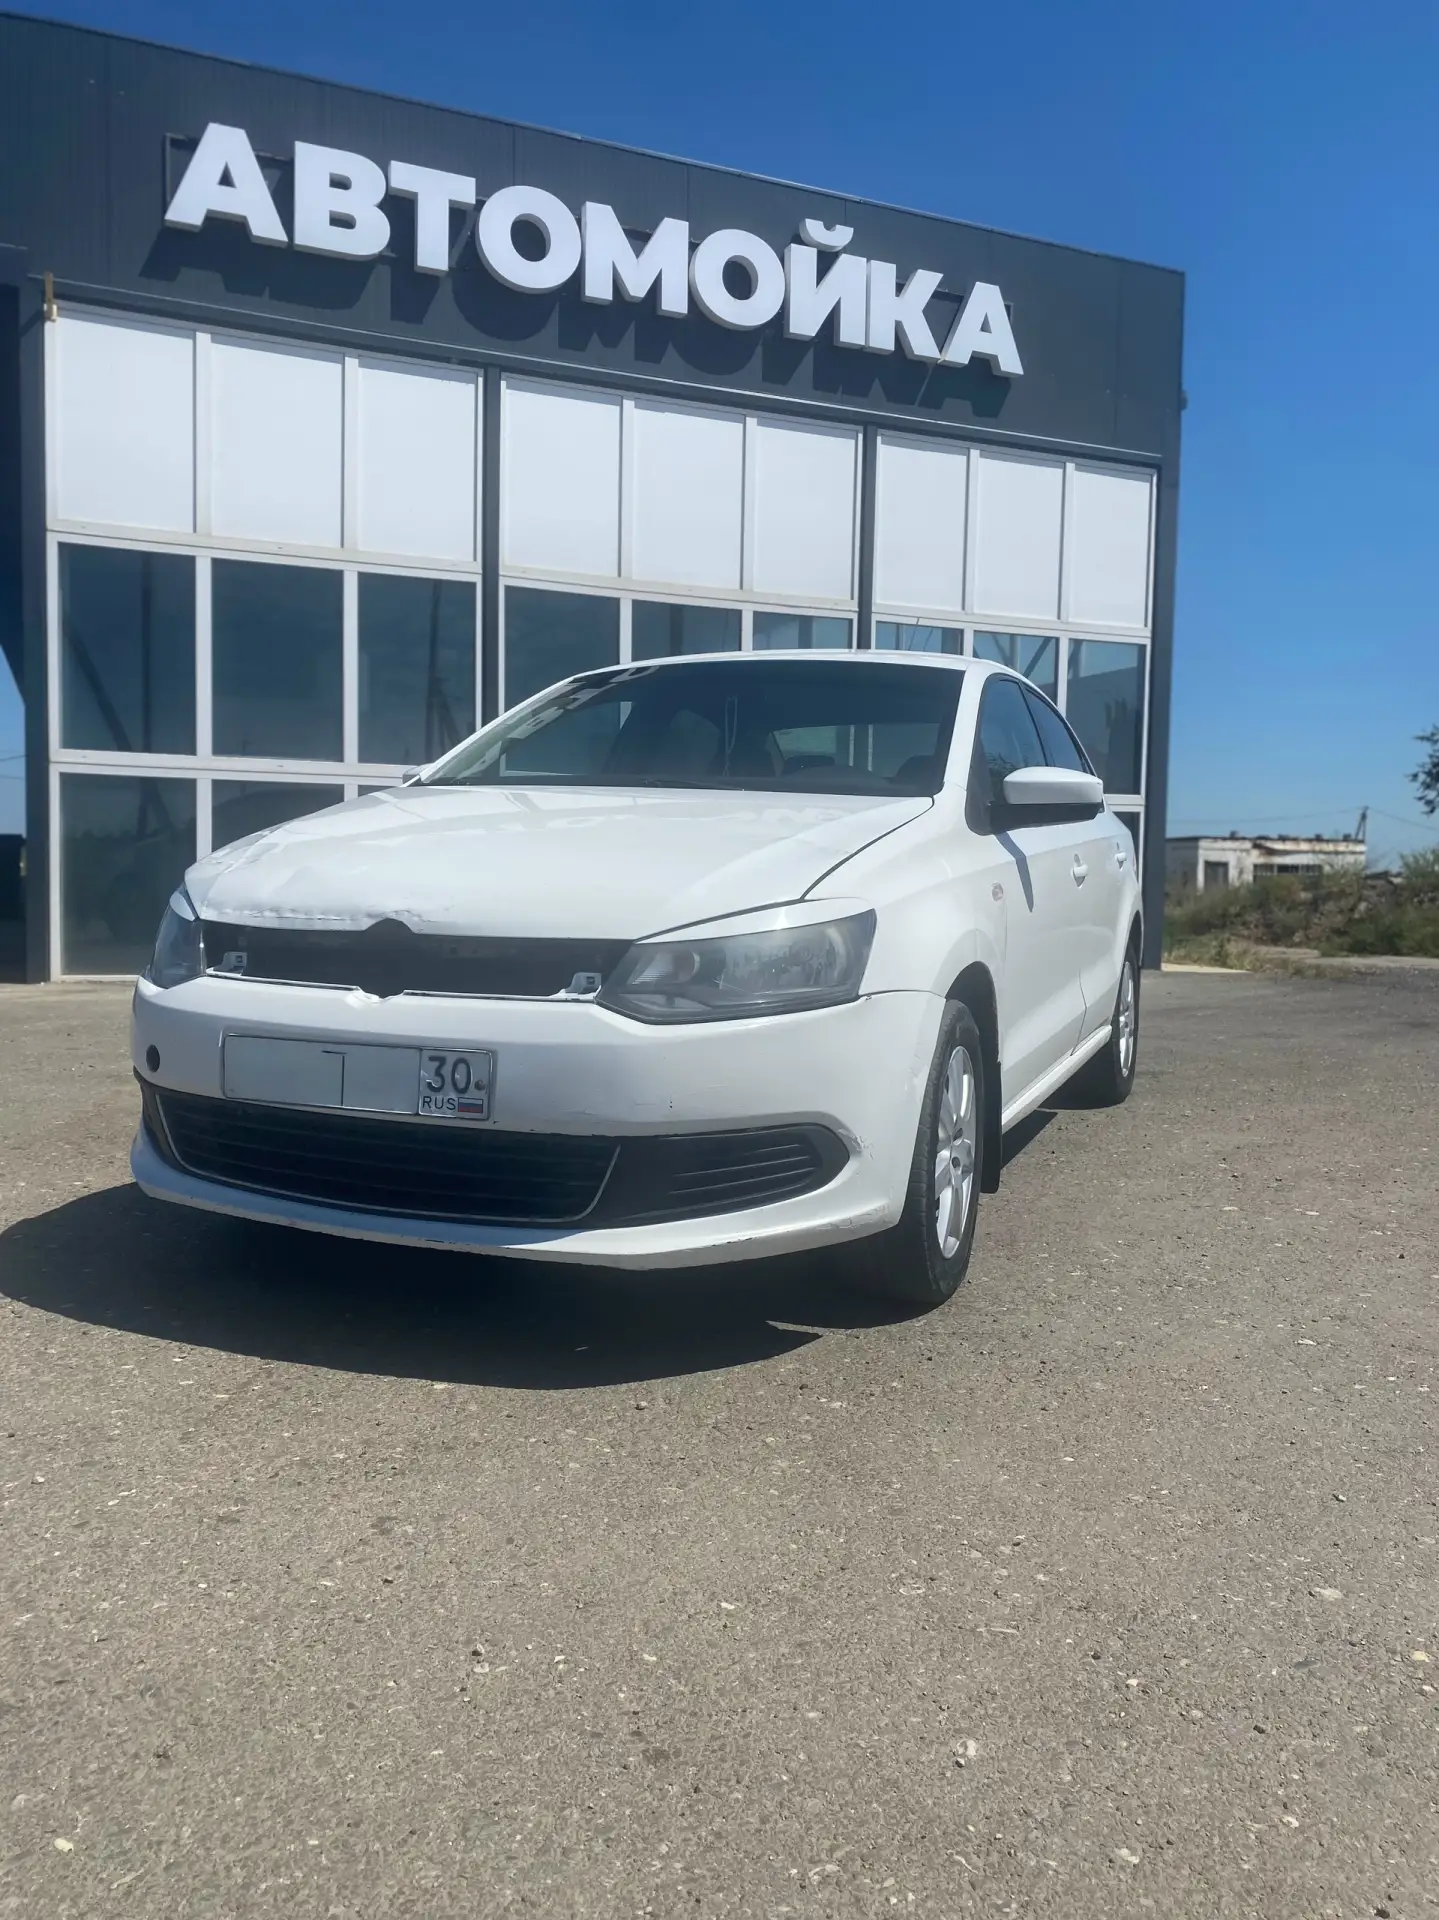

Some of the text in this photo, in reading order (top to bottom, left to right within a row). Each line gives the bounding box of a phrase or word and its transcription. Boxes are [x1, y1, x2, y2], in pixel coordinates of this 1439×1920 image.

[164, 122, 1024, 377] АВТОМОЙКА
[427, 1055, 472, 1094] 30
[422, 1096, 456, 1110] RUS
